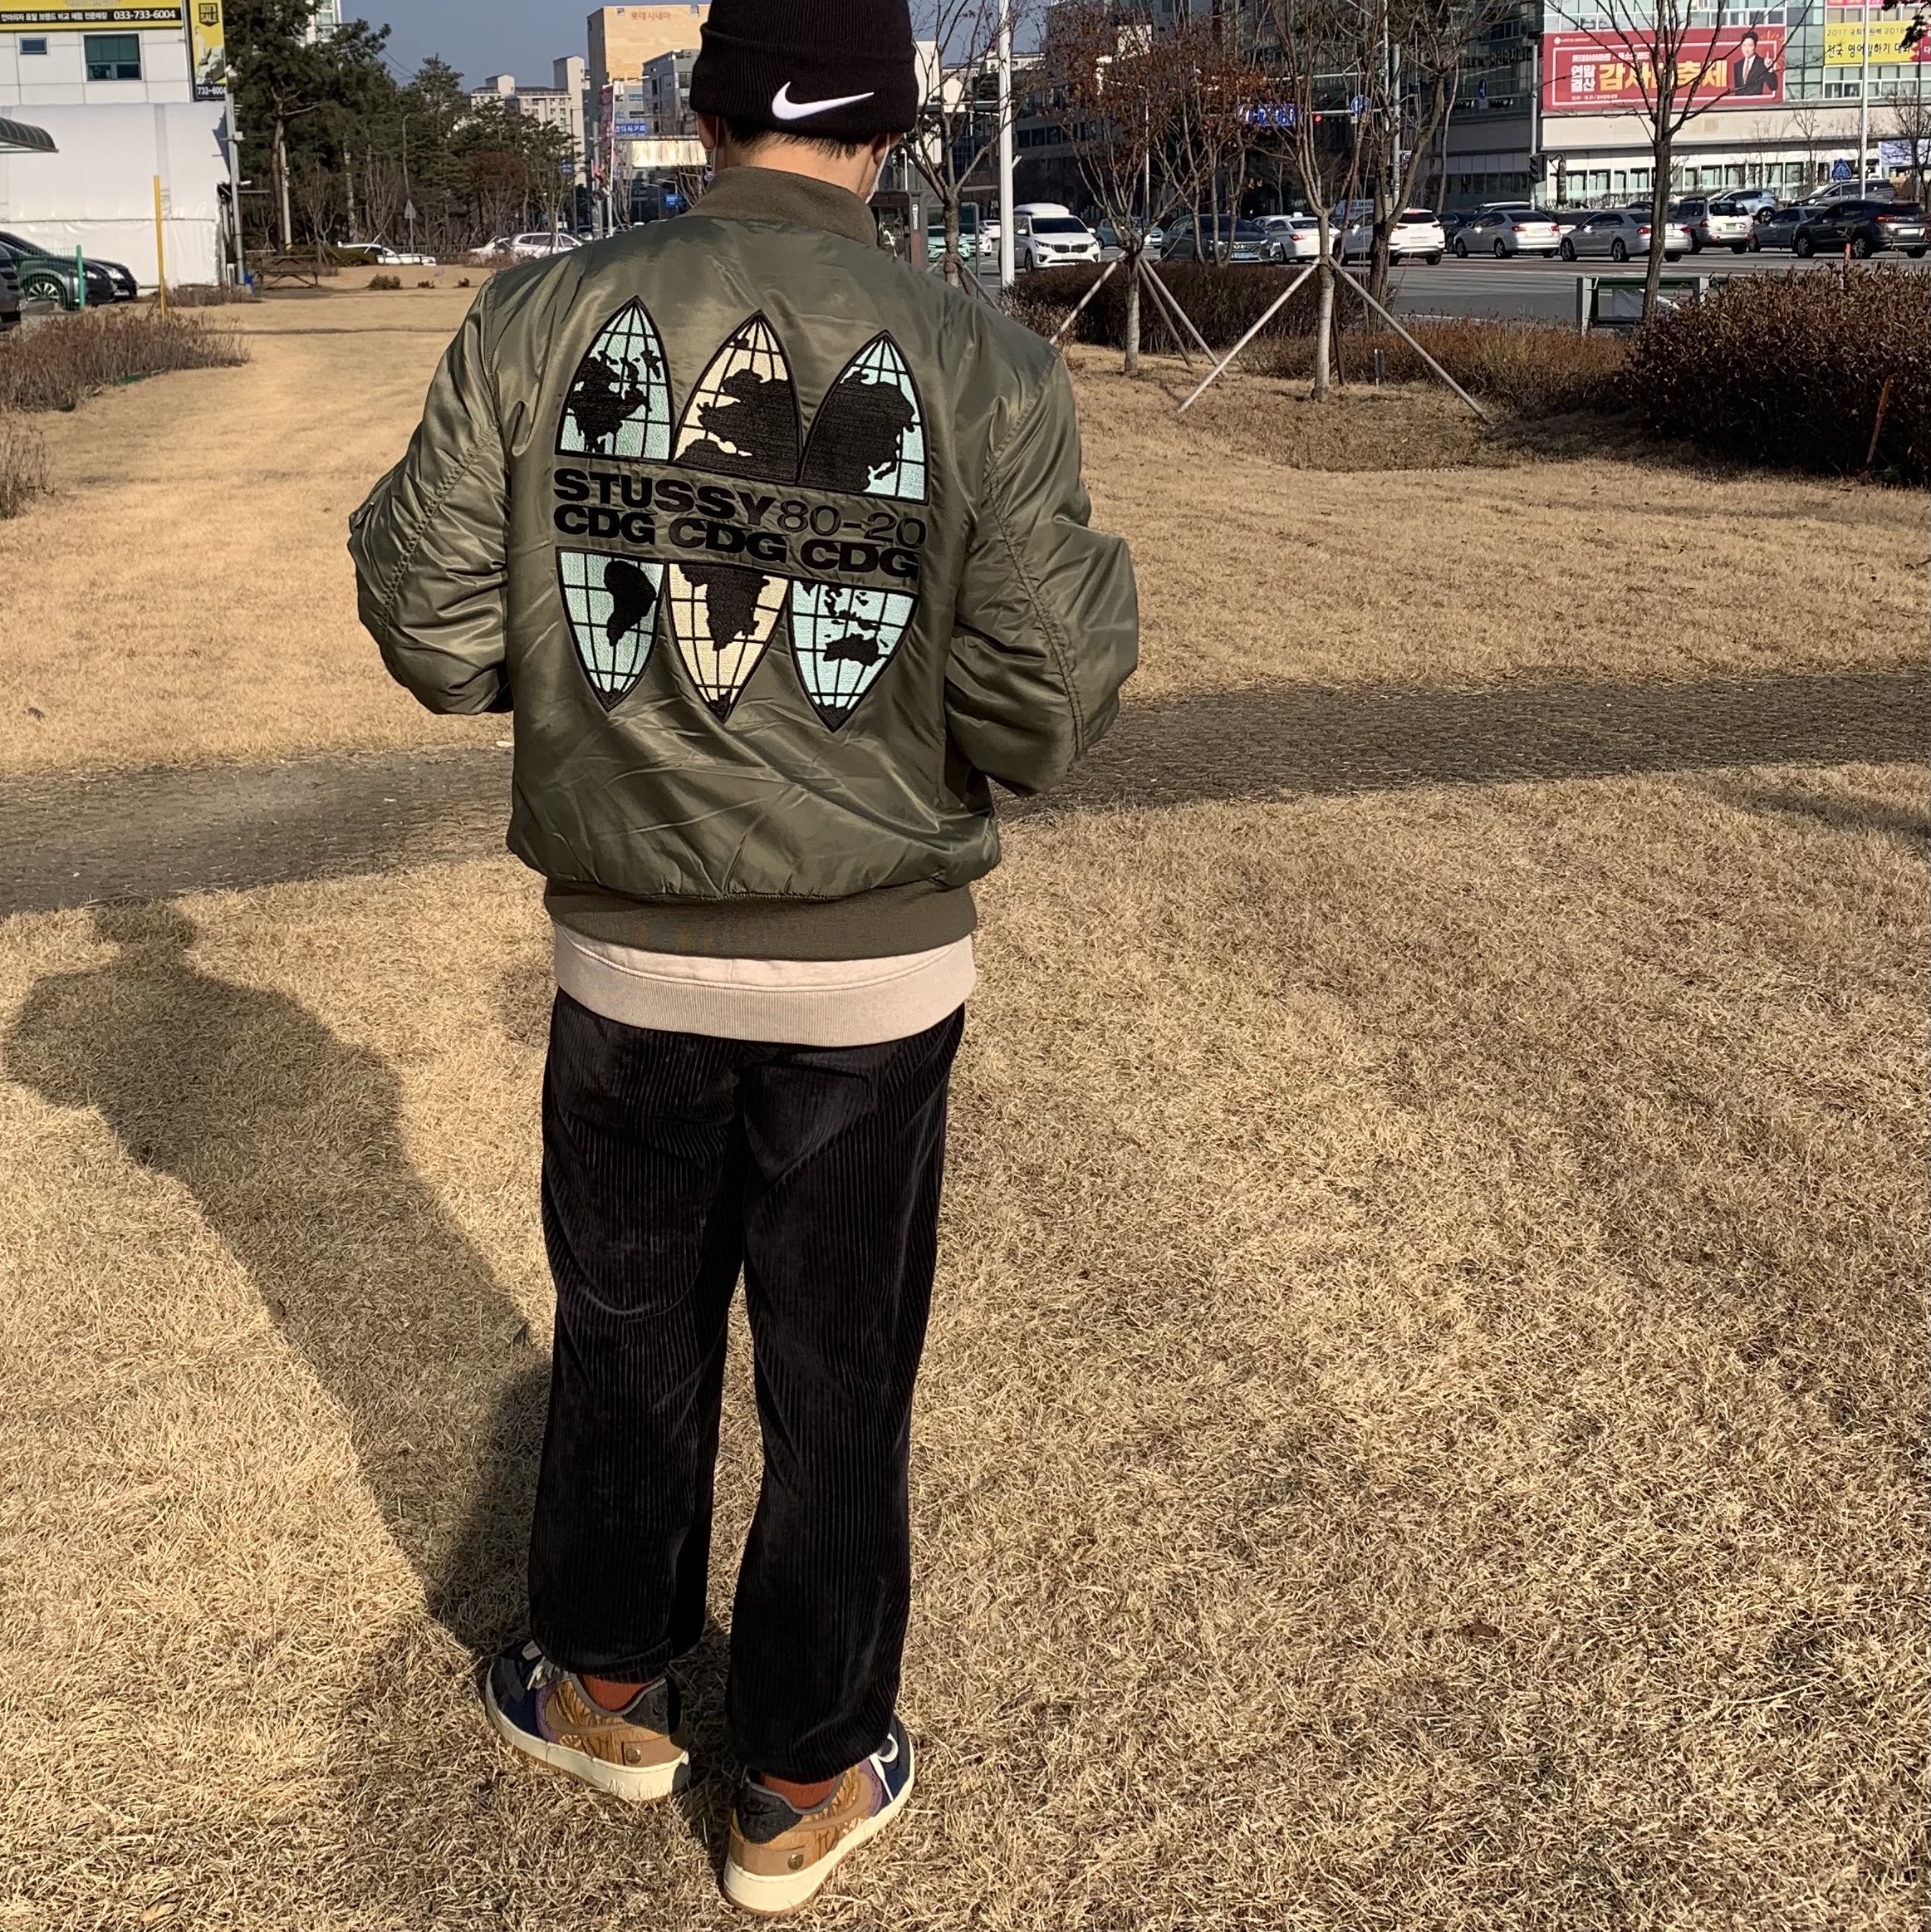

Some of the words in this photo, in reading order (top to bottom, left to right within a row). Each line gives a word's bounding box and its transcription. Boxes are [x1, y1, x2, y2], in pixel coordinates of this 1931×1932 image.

[113, 10, 176, 20] 033-733-6004
[631, 12, 672, 21] 롯데시네마
[1827, 28, 1846, 37] 2017
[1850, 27, 1881, 37] 국회원배
[1599, 60, 1728, 91] 감사축제
[553, 468, 777, 526] STUSSY
[777, 500, 927, 549] 80-20
[553, 503, 657, 545] CDG
[669, 517, 790, 563] CDG
[801, 538, 921, 581] CDG
